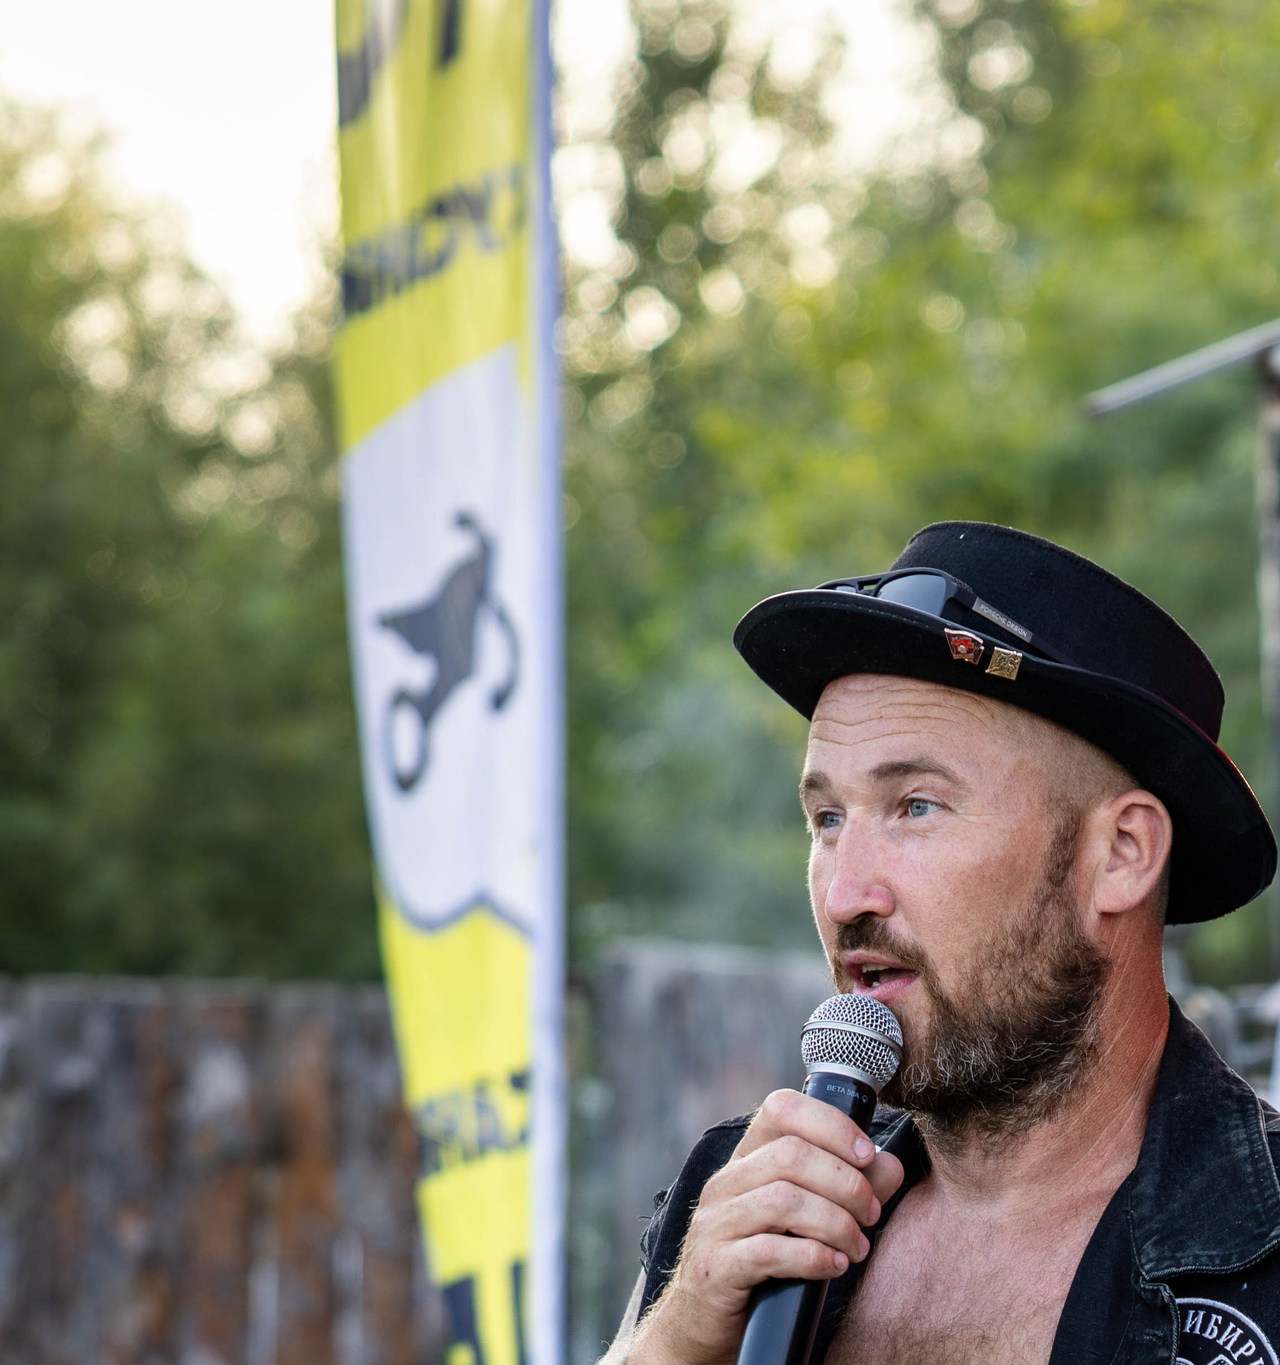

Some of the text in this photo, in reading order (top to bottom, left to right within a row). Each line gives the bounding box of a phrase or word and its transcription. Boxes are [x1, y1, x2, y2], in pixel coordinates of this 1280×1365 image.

[980, 604, 1028, 638] PORSCHE DESIGN
[826, 1084, 846, 1095] BETA
